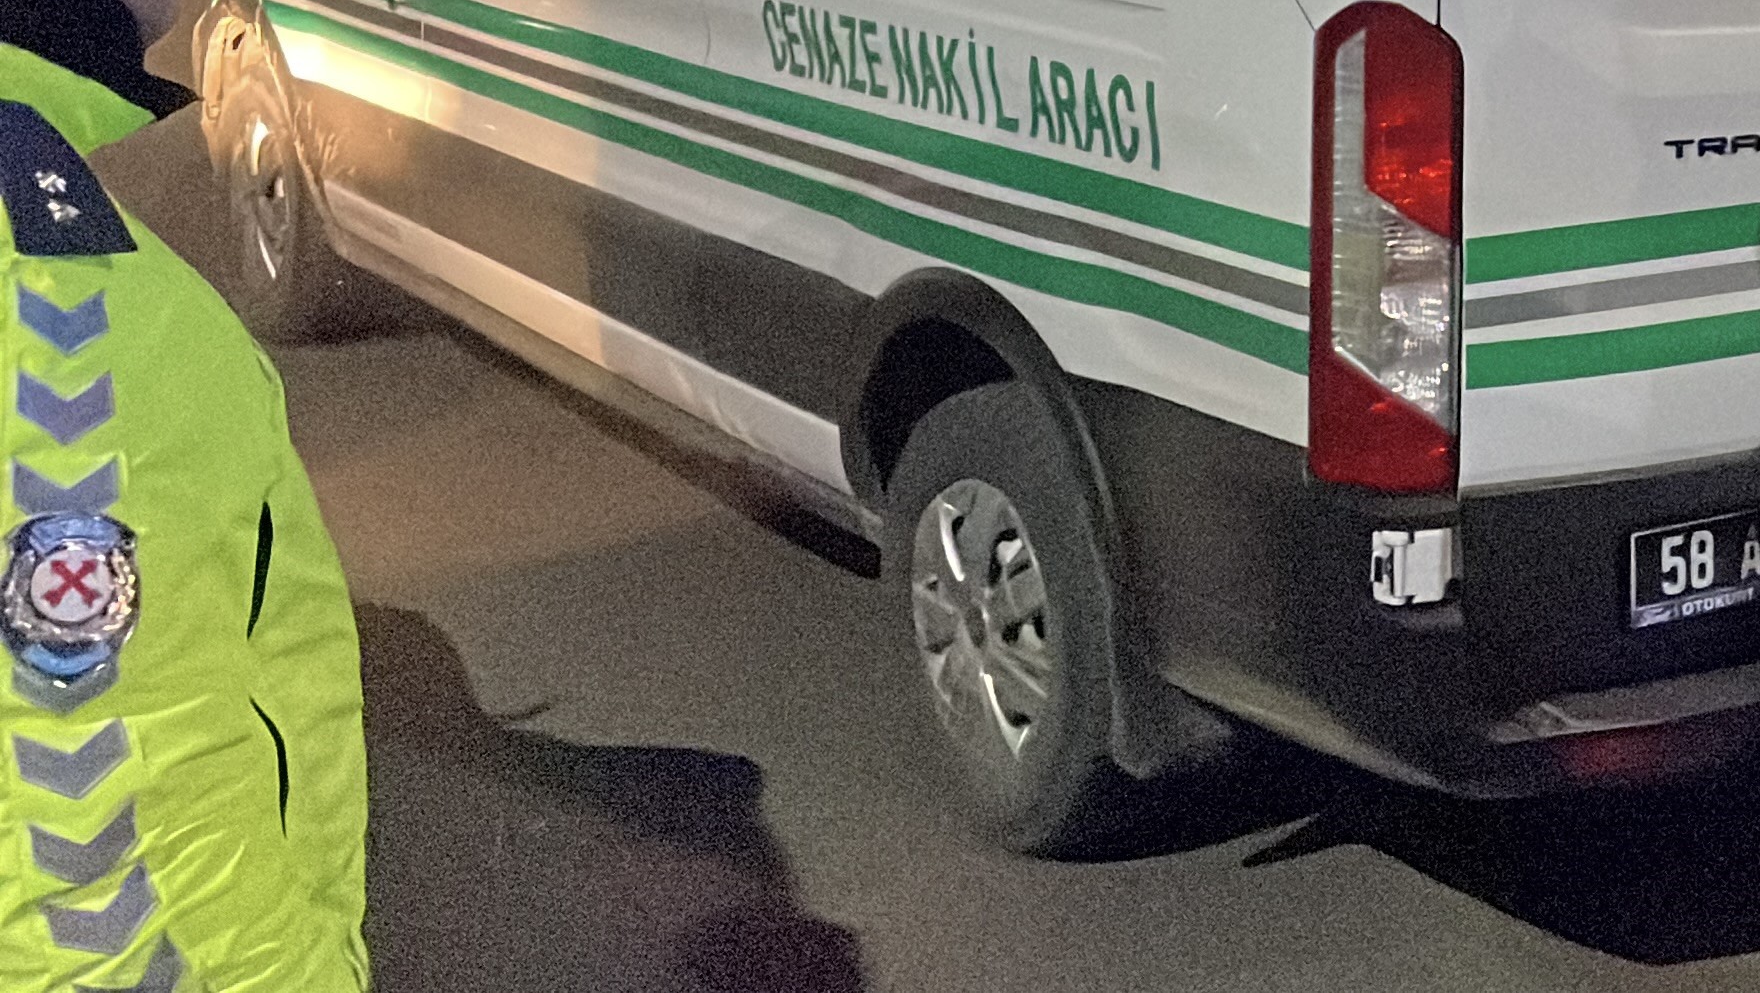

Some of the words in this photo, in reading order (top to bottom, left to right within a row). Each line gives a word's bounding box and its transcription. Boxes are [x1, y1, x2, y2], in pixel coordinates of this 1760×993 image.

[762, 0, 888, 99] CENAZE
[888, 25, 1020, 133] NAKİL
[1029, 55, 1160, 171] ARACI
[1661, 530, 1714, 595] 58
